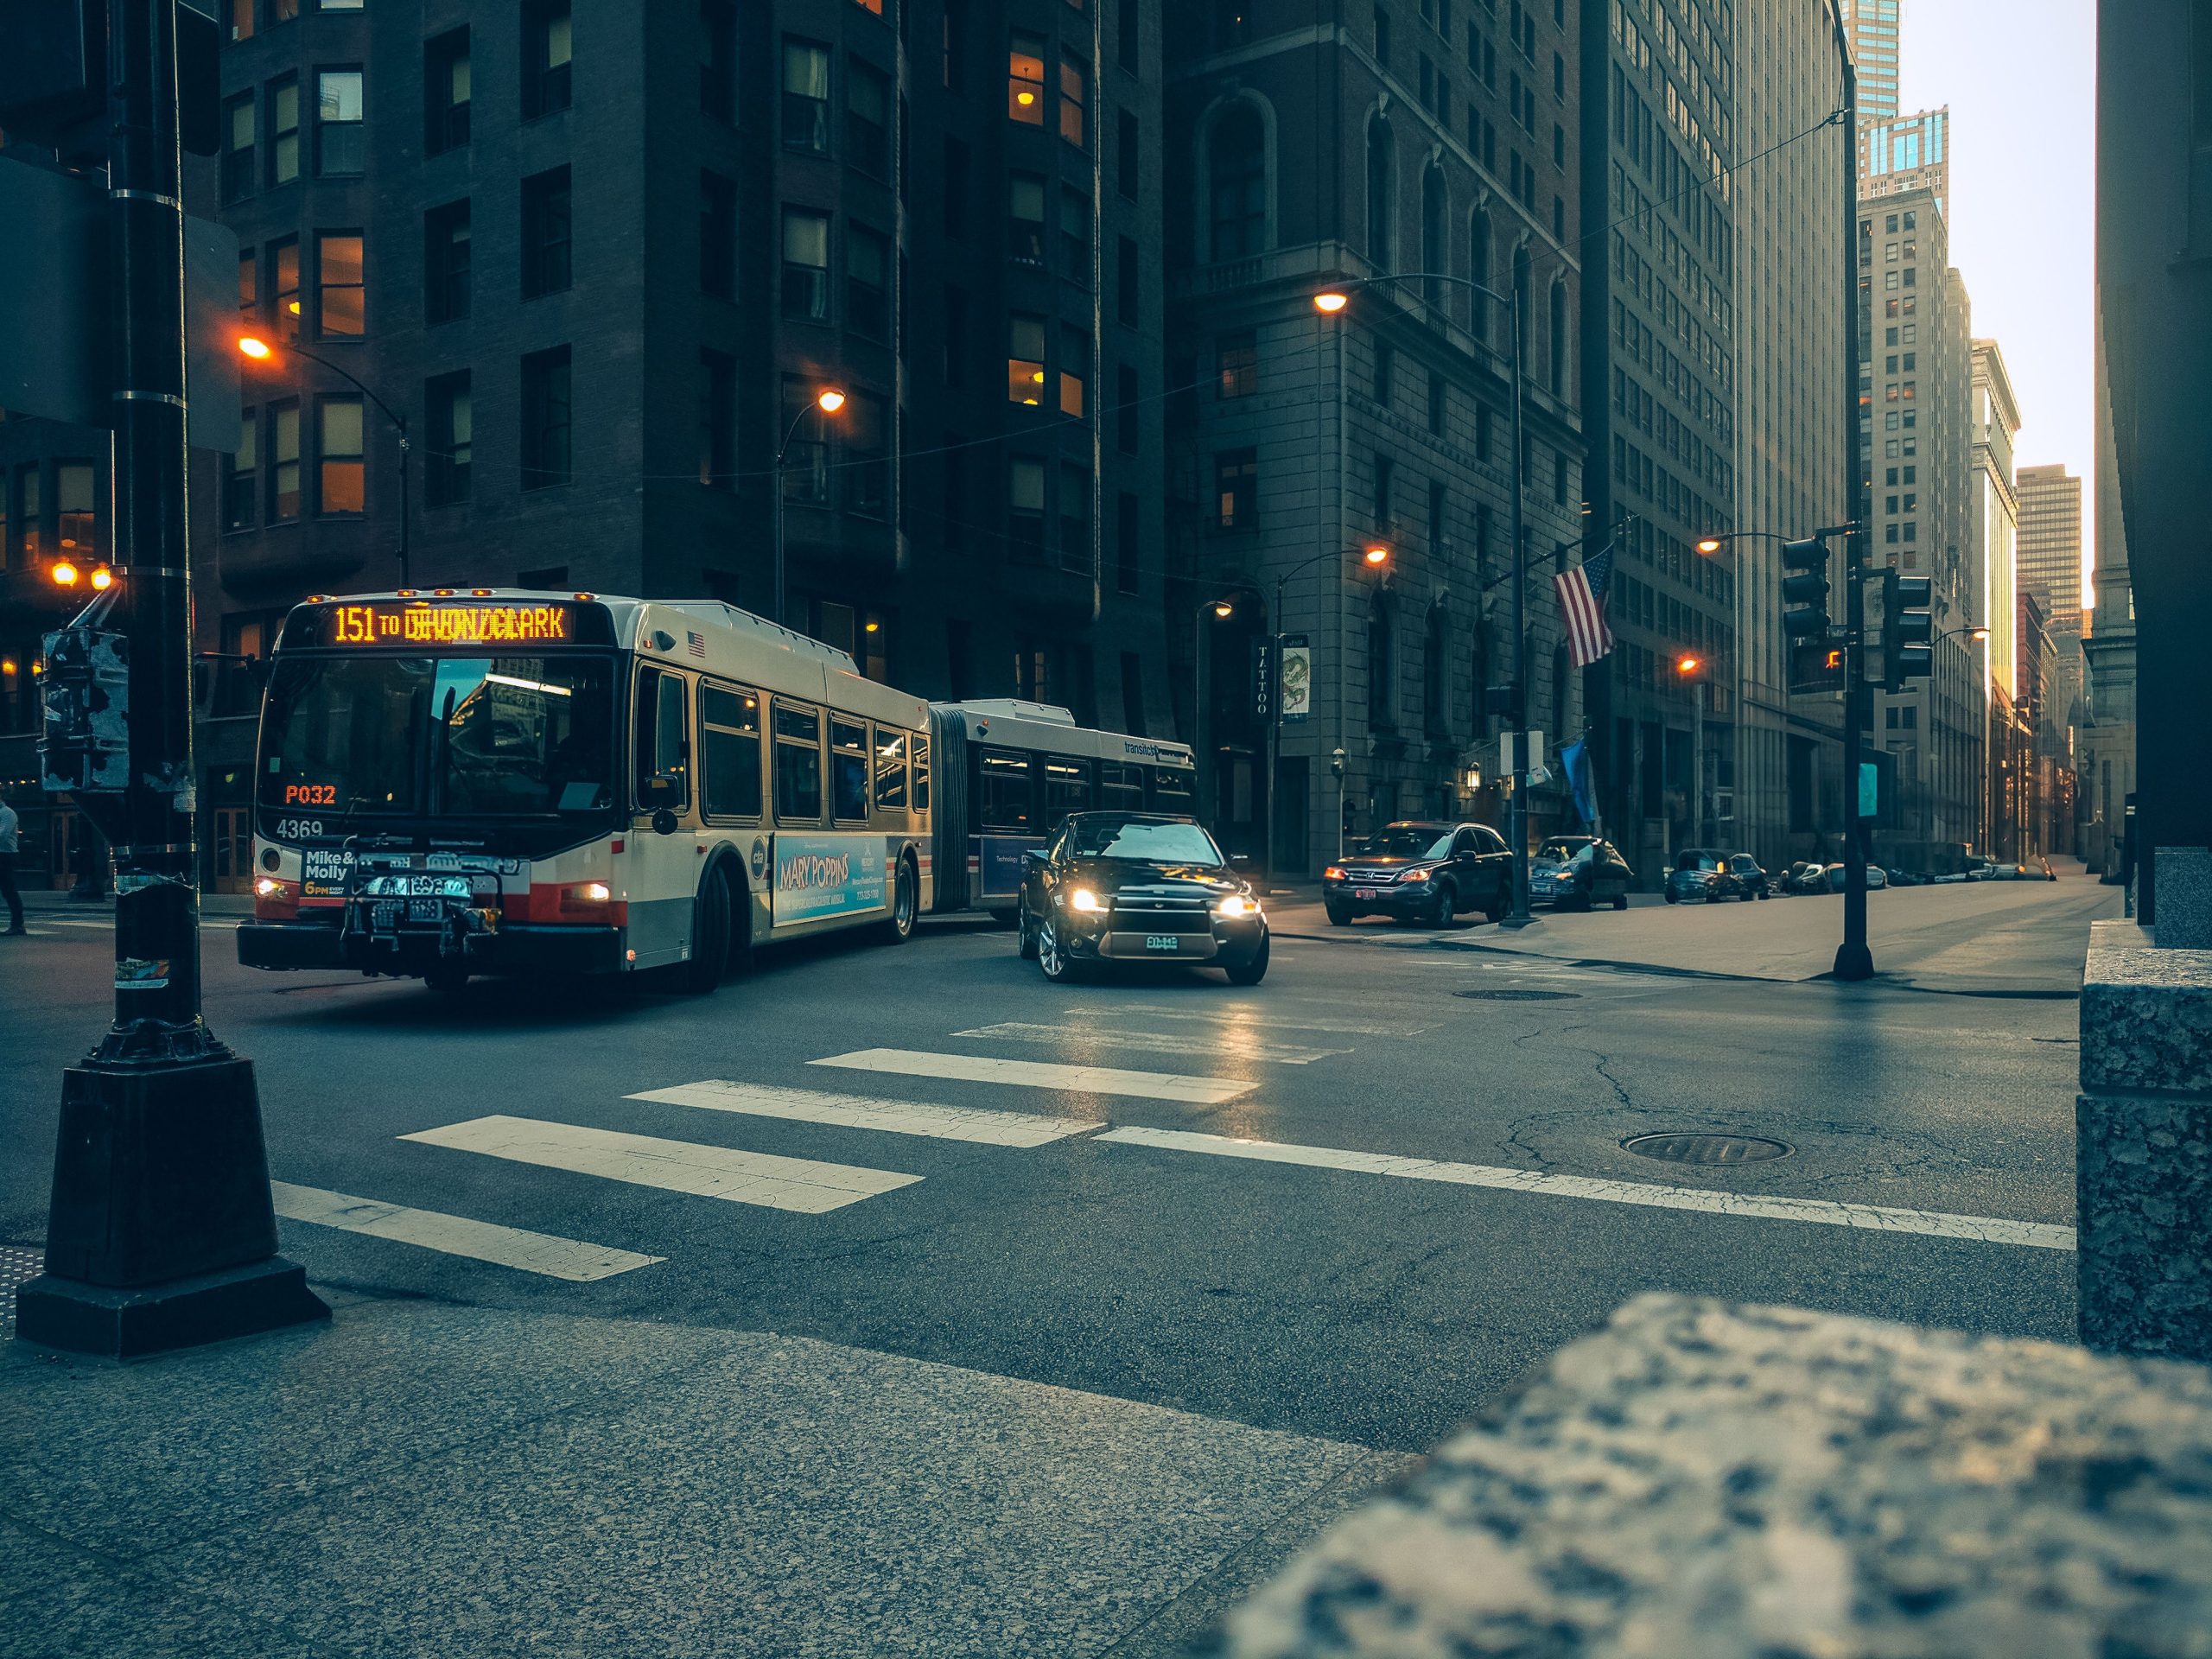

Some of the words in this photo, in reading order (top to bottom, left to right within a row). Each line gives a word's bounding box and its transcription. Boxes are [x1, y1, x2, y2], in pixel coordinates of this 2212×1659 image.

[335, 607, 375, 641] 151
[378, 614, 400, 636] TO
[1257, 646, 1268, 715] TATTOO
[276, 819, 323, 839] 4369
[306, 851, 342, 865] Mike
[343, 851, 354, 865] &
[753, 852, 764, 864] cta
[996, 855, 1018, 864] Technology
[305, 865, 347, 881] Molly
[779, 855, 810, 891] MARY
[812, 852, 849, 888] POPPINS
